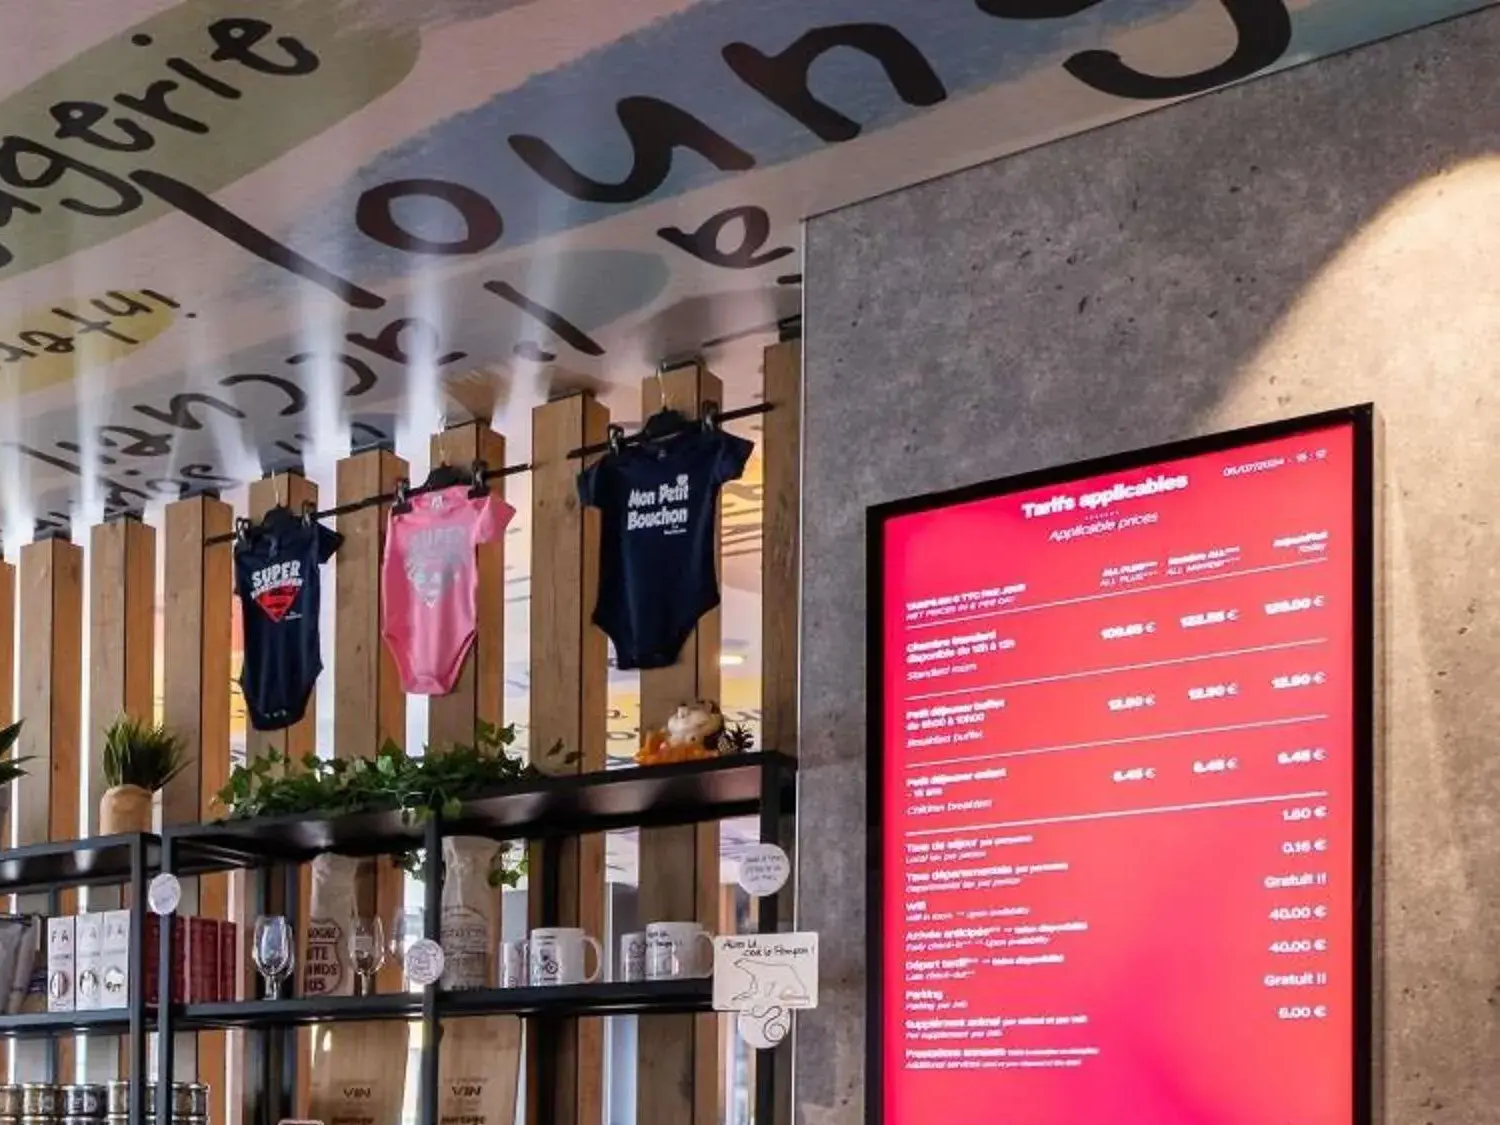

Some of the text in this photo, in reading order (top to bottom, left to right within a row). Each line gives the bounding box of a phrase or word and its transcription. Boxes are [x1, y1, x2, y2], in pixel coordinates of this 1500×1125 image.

[627, 488, 655, 508] Mon
[1021, 474, 1189, 519] Tarifs applicables
[627, 506, 689, 531] Bouchon
[1048, 512, 1159, 542] Applicable prices
[251, 559, 301, 588] SUPER
[1313, 594, 1325, 607] €
[1226, 608, 1239, 621] €
[1145, 621, 1157, 633] €
[1313, 671, 1326, 684] €
[1226, 682, 1239, 695] €
[1145, 694, 1156, 706] €
[1312, 748, 1326, 760] €
[1226, 757, 1238, 770] €
[1145, 767, 1156, 779] €
[1313, 806, 1327, 817] €
[1313, 838, 1328, 851] €
[1263, 873, 1314, 888] Gratuit
[1268, 905, 1328, 920] 40.00 €
[1268, 938, 1328, 953] 40.00 €
[1263, 972, 1314, 987] Gratuit
[905, 989, 943, 1001] Parking
[1313, 1005, 1328, 1018] €
[451, 1085, 483, 1098] VIN
